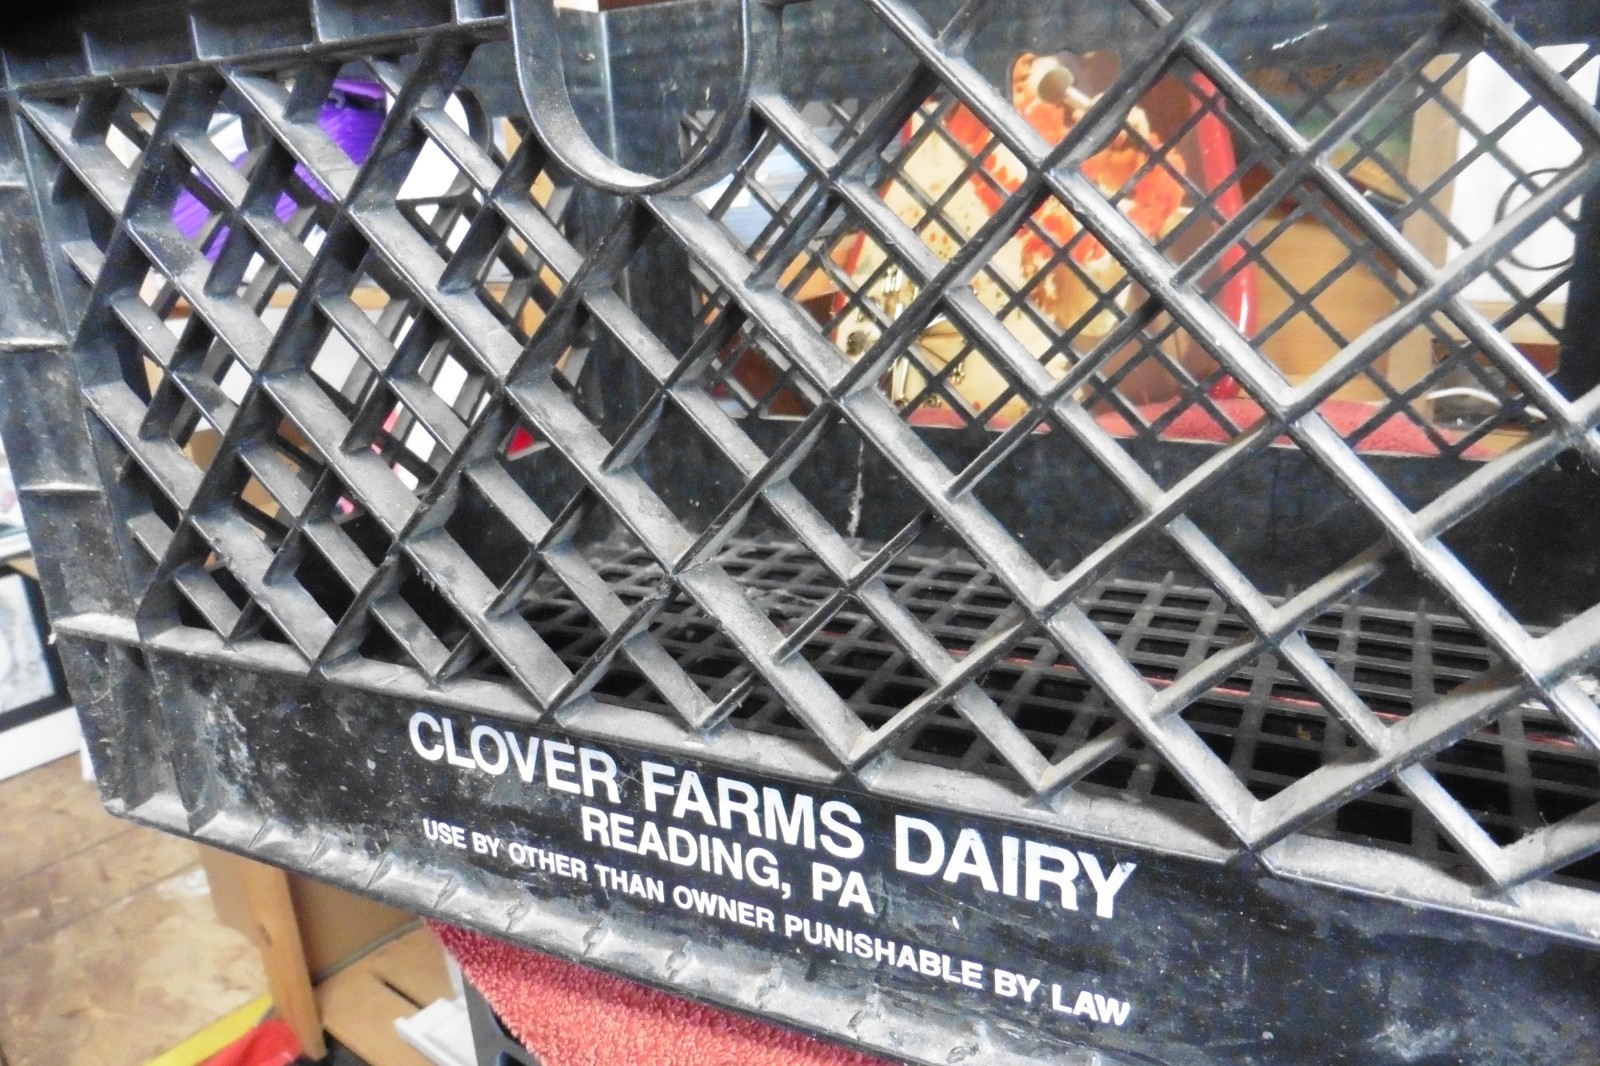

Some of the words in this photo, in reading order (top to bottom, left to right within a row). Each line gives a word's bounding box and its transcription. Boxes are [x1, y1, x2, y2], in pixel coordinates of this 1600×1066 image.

[408, 711, 620, 804] CLOVER
[641, 762, 865, 859] FARMS
[894, 814, 1136, 919] DAIRY
[582, 806, 791, 899] READING,
[812, 862, 876, 914] PA
[423, 819, 466, 849] USE
[472, 832, 501, 858] BY
[508, 841, 587, 882] OTHER
[594, 863, 664, 902] THAN
[672, 886, 775, 932] OWNER
[785, 914, 983, 989] PUNISHABLE
[994, 969, 1040, 1003] BY
[1052, 984, 1130, 1026] LAW
